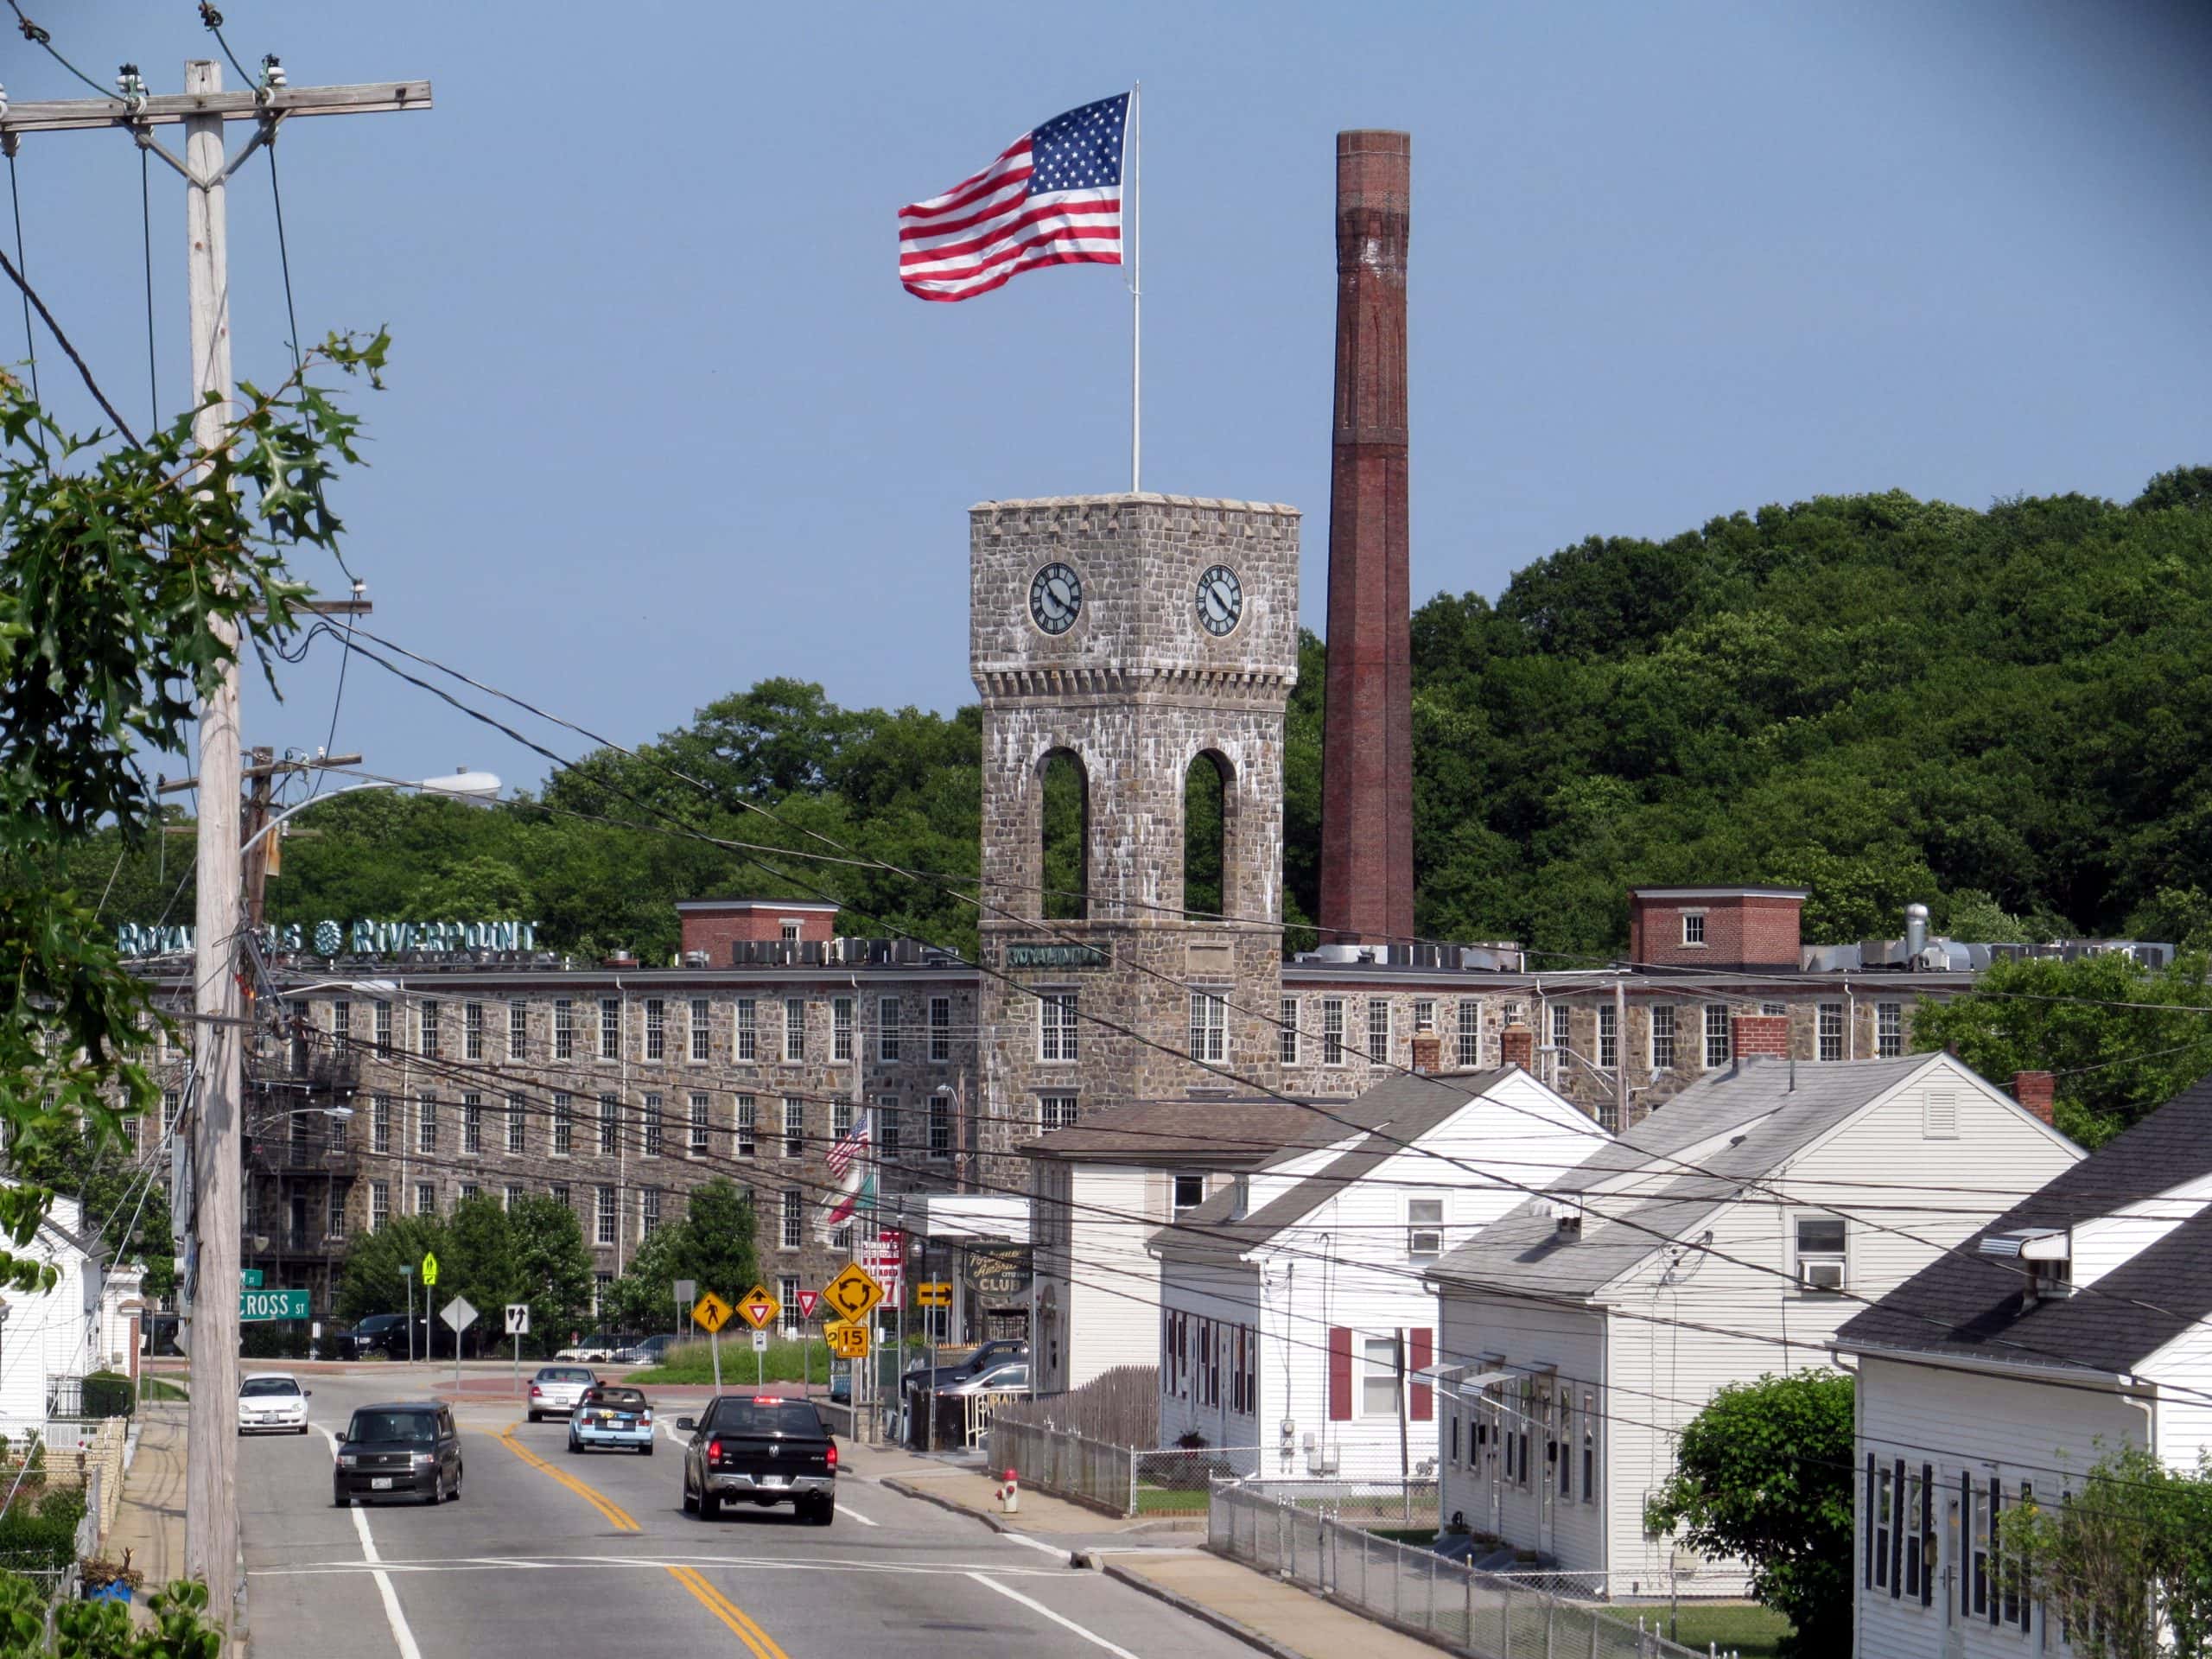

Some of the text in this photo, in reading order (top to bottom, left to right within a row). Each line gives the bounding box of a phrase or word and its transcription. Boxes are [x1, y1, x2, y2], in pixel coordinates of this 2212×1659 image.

[353, 918, 540, 952] RIVERPOINT
[979, 1278, 1020, 1292] CLUB
[296, 1303, 305, 1314] ST
[843, 1331, 863, 1344] 15
